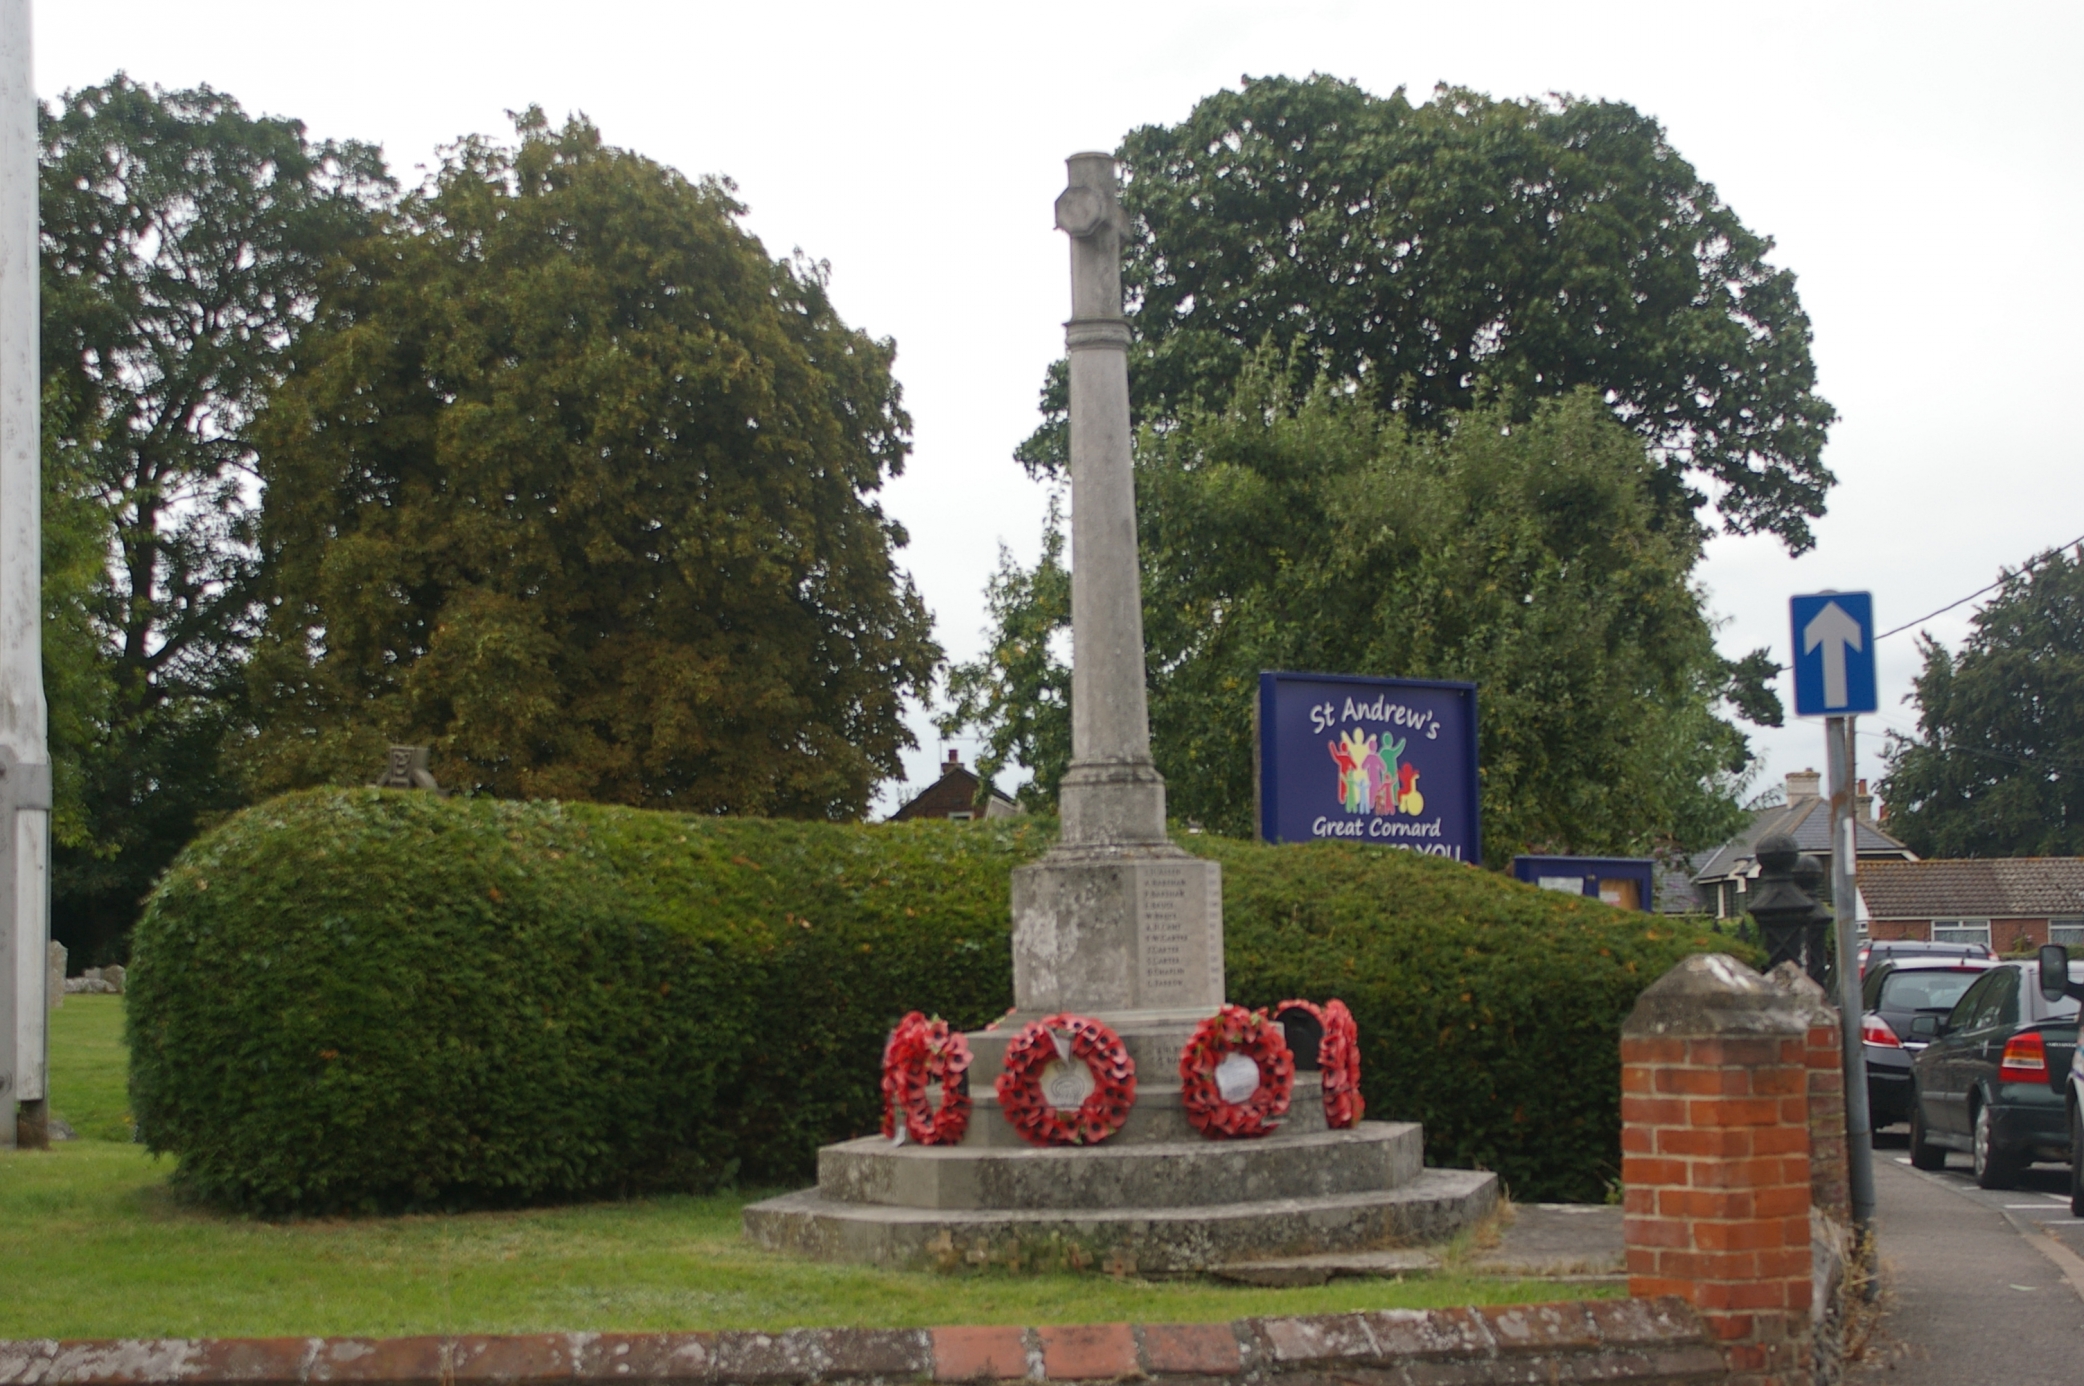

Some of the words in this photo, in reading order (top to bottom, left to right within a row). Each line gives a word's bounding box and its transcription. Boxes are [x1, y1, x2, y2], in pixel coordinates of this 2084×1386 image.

[1310, 701, 1335, 734] St
[1341, 693, 1441, 739] Andrew's
[1312, 816, 1364, 838] Great
[1369, 817, 1442, 837] Cornard
